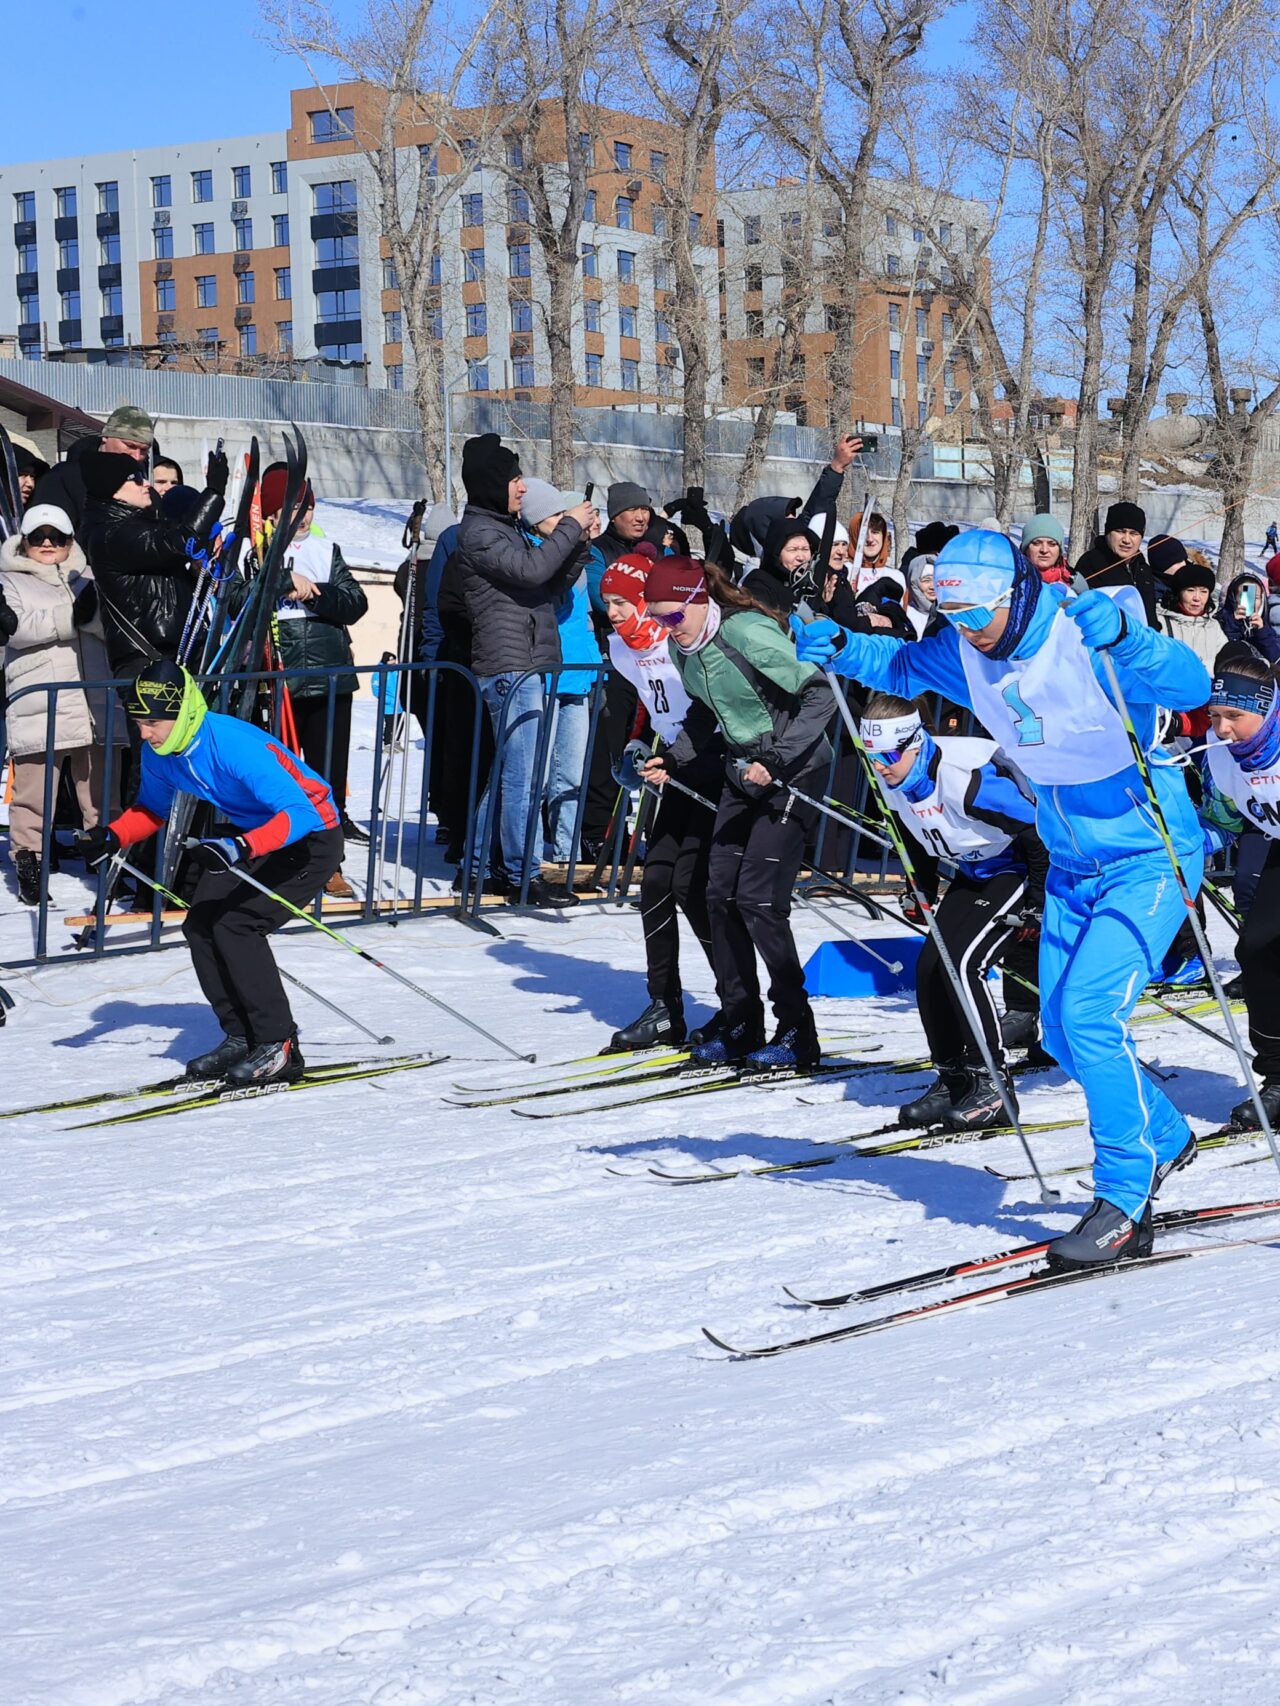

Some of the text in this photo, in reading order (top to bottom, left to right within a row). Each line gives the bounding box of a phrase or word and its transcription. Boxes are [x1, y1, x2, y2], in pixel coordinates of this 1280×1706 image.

[648, 679, 670, 713] 23
[1002, 680, 1045, 747] 1
[171, 1079, 227, 1095] FISCH
[739, 1071, 797, 1084] FISCHER
[219, 1082, 290, 1102] FISCHER
[918, 1131, 984, 1149] FISCHER
[1095, 1220, 1133, 1249] SPINE
